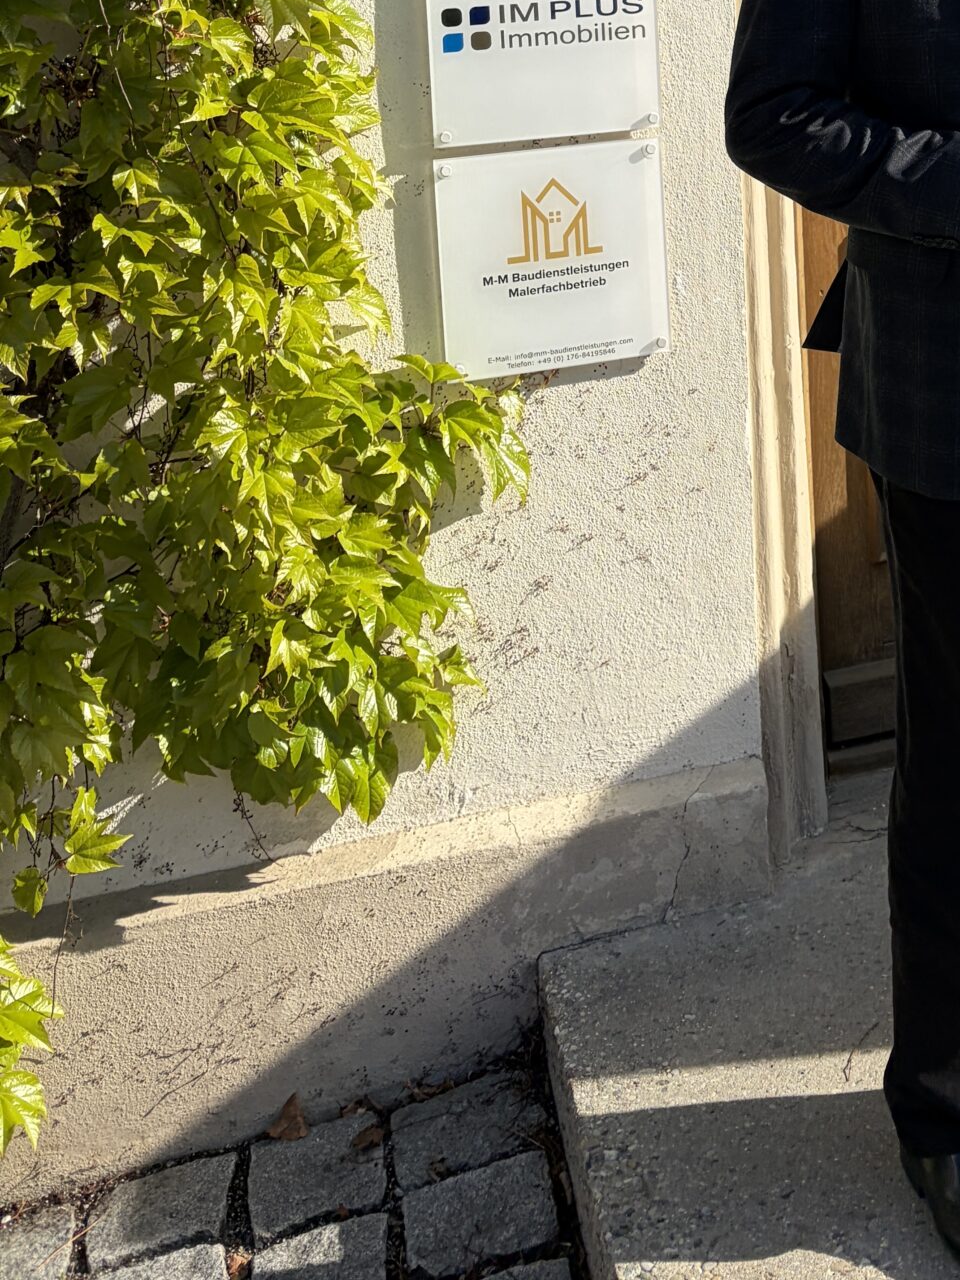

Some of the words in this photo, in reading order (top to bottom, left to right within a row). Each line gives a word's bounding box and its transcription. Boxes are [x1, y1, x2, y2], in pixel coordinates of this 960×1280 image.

[499, 2, 539, 24] IM
[500, 22, 646, 49] Immobilien
[482, 275, 509, 287] M-M
[512, 259, 630, 284] Baudienstleistungen
[508, 276, 607, 298] Malerfachbetrieb
[488, 355, 512, 364] E-Mail:
[514, 337, 634, 360] info@mm-baudienstleistungen.com
[507, 360, 535, 369] Telefon:
[553, 355, 564, 363] (0)
